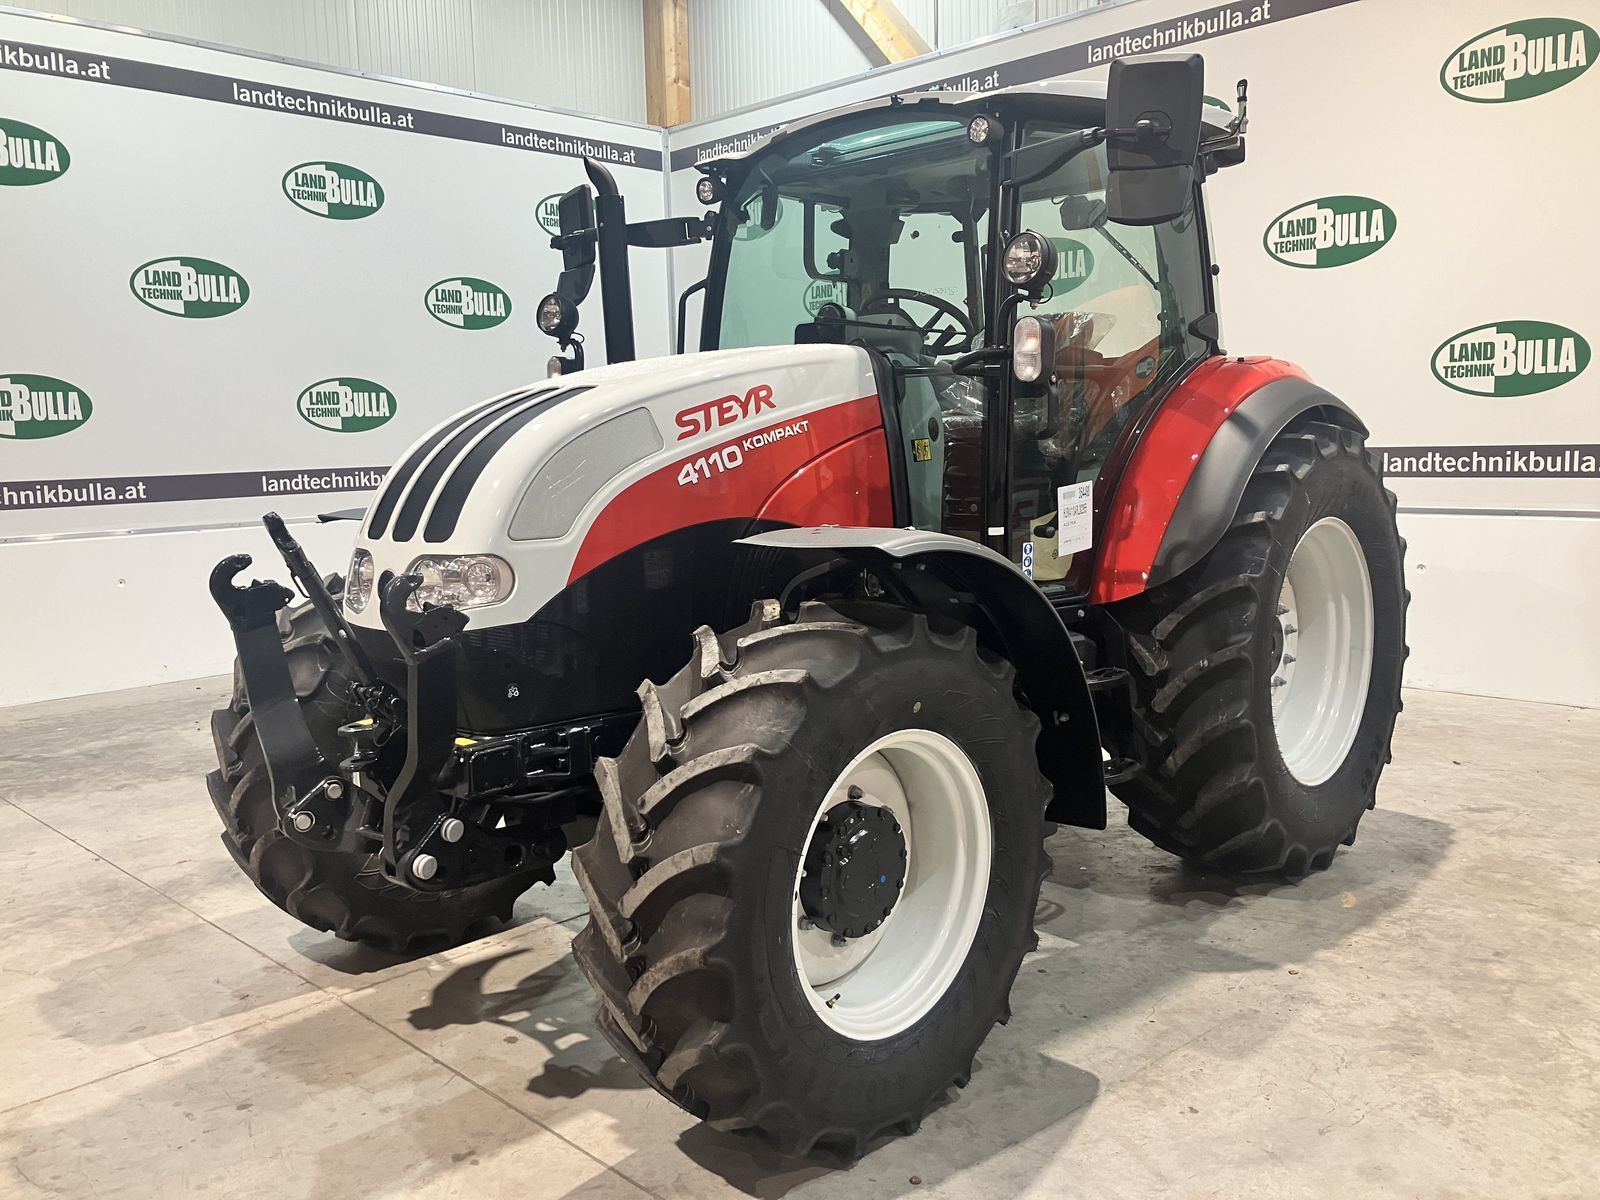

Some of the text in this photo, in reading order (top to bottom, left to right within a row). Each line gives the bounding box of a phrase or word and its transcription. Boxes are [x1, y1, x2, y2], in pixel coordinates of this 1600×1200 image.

[1087, 0, 1271, 64] landtechnikbulla.at
[1458, 45, 1505, 73] LAND
[1504, 29, 1587, 81] BULLA
[1452, 67, 1506, 90] TECHNIK
[232, 82, 414, 128] landtechnikbulla.at
[501, 127, 636, 164] landtechnikbulla.at
[294, 172, 326, 190] LAND
[326, 170, 378, 208] BULLA
[291, 188, 328, 202] TECHNIK
[1278, 217, 1317, 239] LAND
[1315, 207, 1385, 250] BULLA
[1273, 237, 1317, 254] TECHNIK
[144, 269, 182, 287] LAND
[181, 265, 241, 304] BULLA
[141, 287, 183, 301] TECHNIK
[435, 288, 462, 303] LAND
[462, 284, 506, 317] BULLA
[811, 284, 833, 300] LAND
[432, 303, 463, 315] TECHNIK
[1449, 341, 1496, 363] LAND
[1494, 332, 1577, 377] BULLA
[1443, 363, 1495, 379] TECHNIK
[11, 383, 83, 422] BULLA
[308, 391, 340, 406] LAND
[340, 385, 390, 418] BULLA
[306, 407, 341, 418] TECHNIK
[675, 384, 777, 442] STEYR
[677, 420, 810, 486] 4110 KOMPAKT
[0, 481, 147, 506] hnikbulla.at
